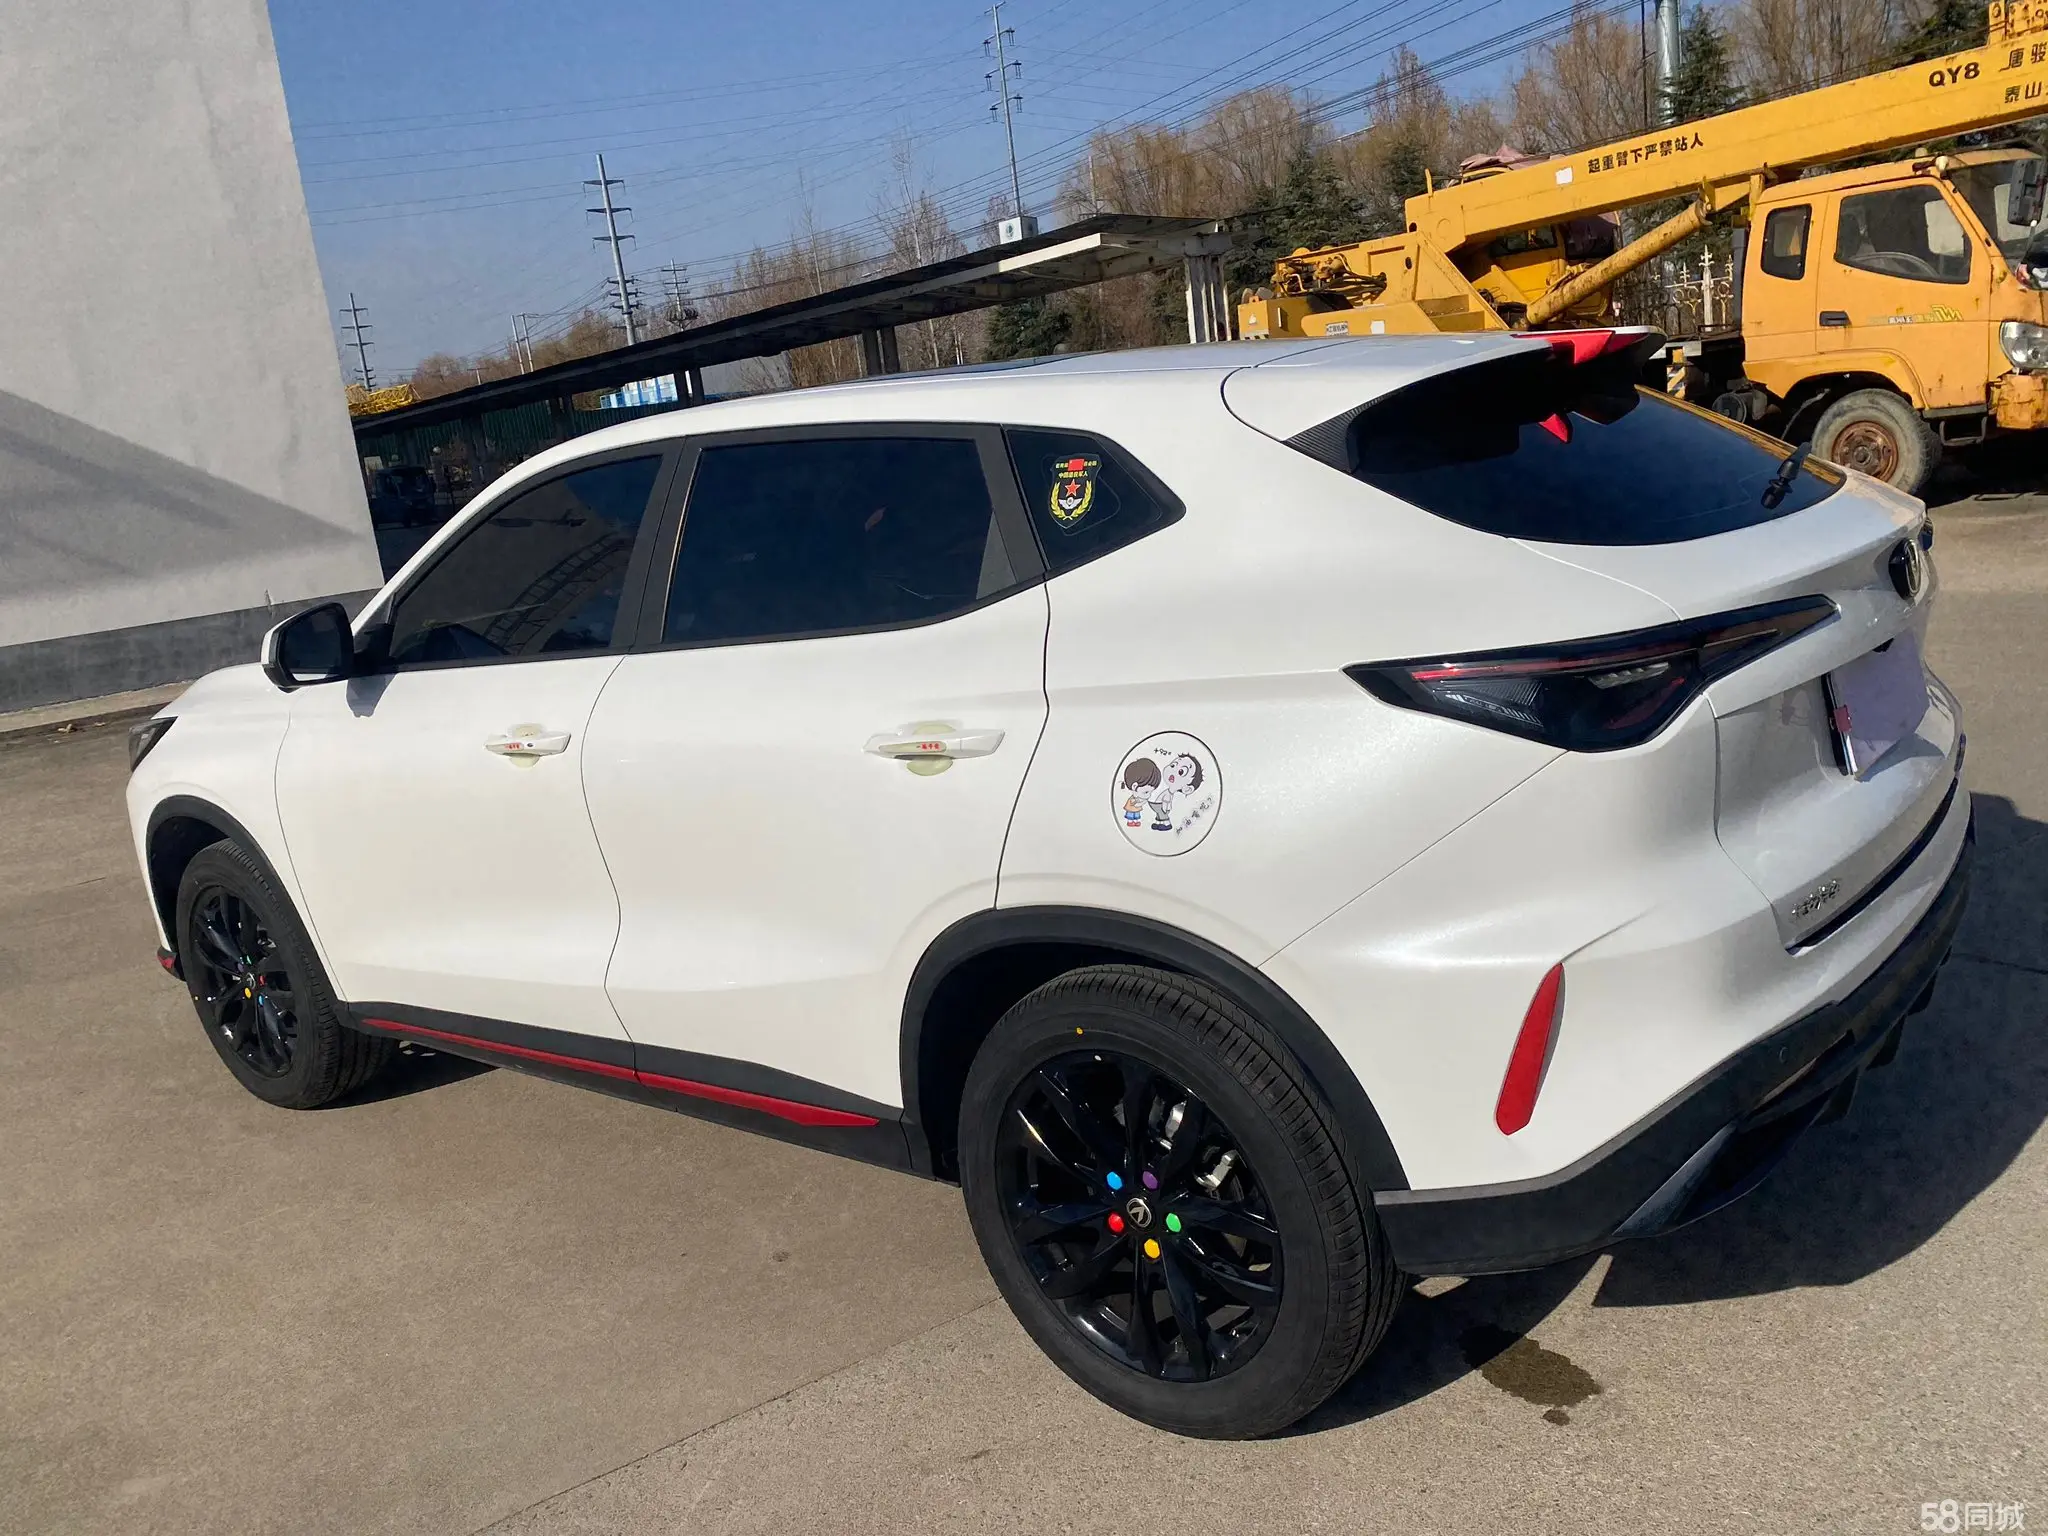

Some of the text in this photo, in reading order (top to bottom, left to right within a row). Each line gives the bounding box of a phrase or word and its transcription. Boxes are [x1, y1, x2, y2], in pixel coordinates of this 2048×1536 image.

[1928, 61, 1981, 88] QY8
[2004, 80, 2048, 104] 泰山
[1587, 131, 1705, 174] 起重臂下严禁站人
